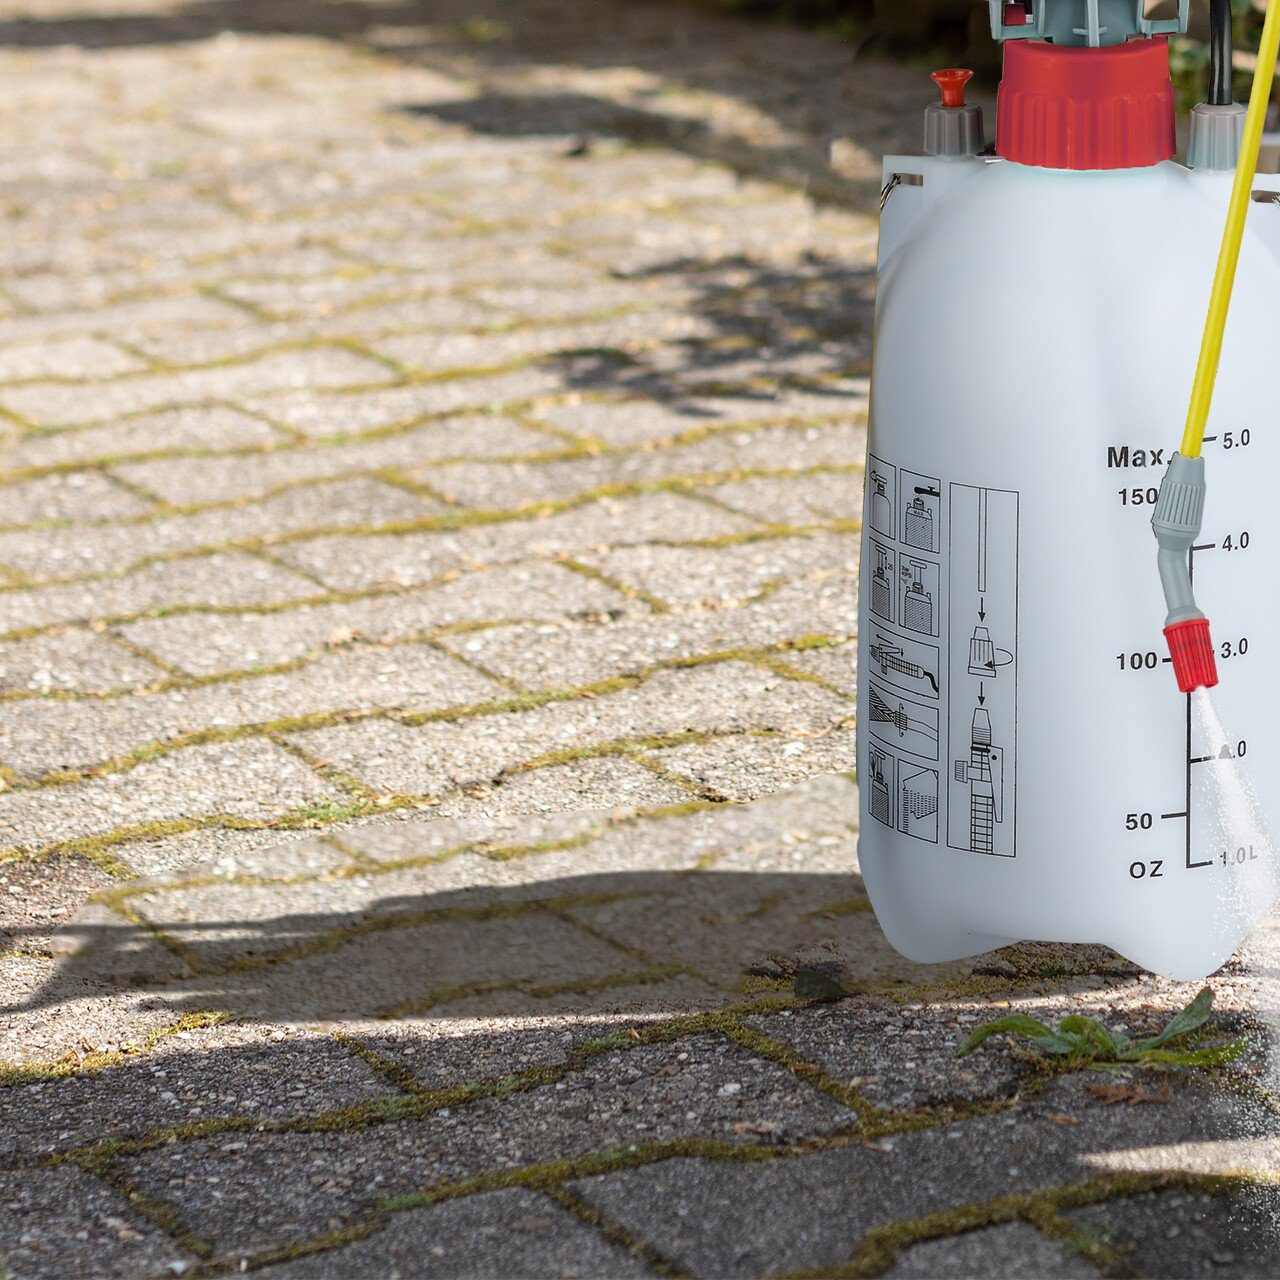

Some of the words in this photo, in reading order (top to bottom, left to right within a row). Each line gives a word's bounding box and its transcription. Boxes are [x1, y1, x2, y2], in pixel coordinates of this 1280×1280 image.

[1223, 428, 1250, 449] 5.0
[1118, 487, 1158, 506] 150
[1222, 531, 1250, 551] 4.0
[1220, 637, 1248, 658] 3.0
[1116, 651, 1158, 670] 100
[1125, 812, 1153, 831] 50
[1129, 860, 1163, 879] OZ
